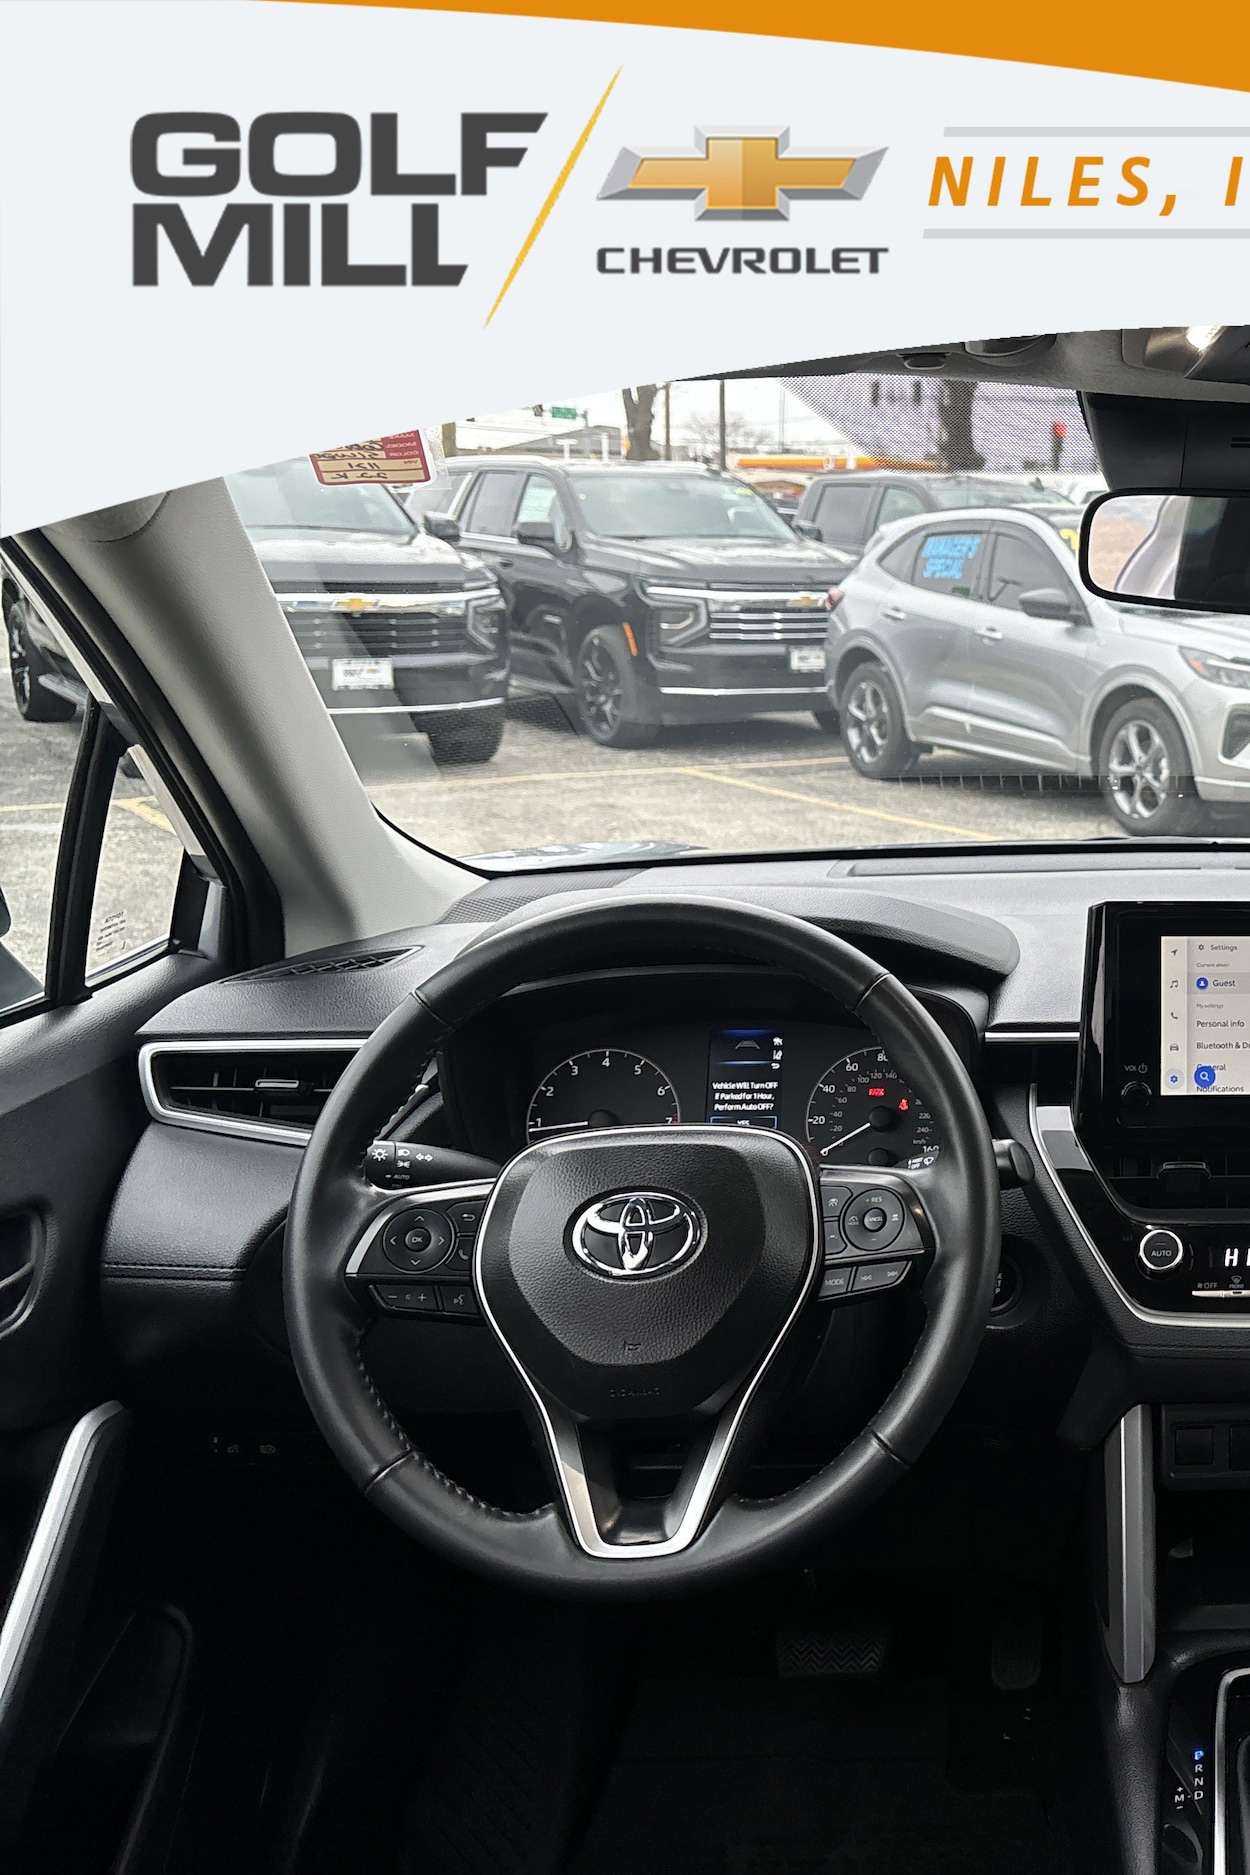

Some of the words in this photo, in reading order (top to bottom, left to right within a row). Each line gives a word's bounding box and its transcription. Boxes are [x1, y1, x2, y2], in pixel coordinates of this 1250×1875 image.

[1210, 944, 1238, 952] Settings
[1213, 979, 1236, 987] Guest
[1196, 1020, 1229, 1028] Personal
[1231, 1020, 1245, 1028] info
[602, 1057, 611, 1067] 4
[571, 1065, 579, 1076] 3
[634, 1065, 642, 1075] 5
[846, 1063, 858, 1072] 60
[712, 1082, 736, 1090] Vehicle
[822, 1085, 835, 1094] 40
[545, 1086, 554, 1097] 2
[657, 1086, 666, 1096] 6
[720, 1092, 741, 1100] Parked
[741, 1092, 753, 1100] for
[757, 1093, 775, 1101] Hour,
[714, 1103, 740, 1111] Perform
[740, 1103, 757, 1111] Auto
[757, 1103, 774, 1111] OFF?
[535, 1118, 542, 1127] 1
[813, 1116, 826, 1125] 20
[832, 1124, 843, 1132] 20
[825, 1278, 845, 1286] MODE
[1194, 1750, 1205, 1760] P
[1194, 1764, 1204, 1773] R
[1194, 1777, 1204, 1787] N
[1174, 1794, 1185, 1803] M
[1194, 1790, 1204, 1800] D
